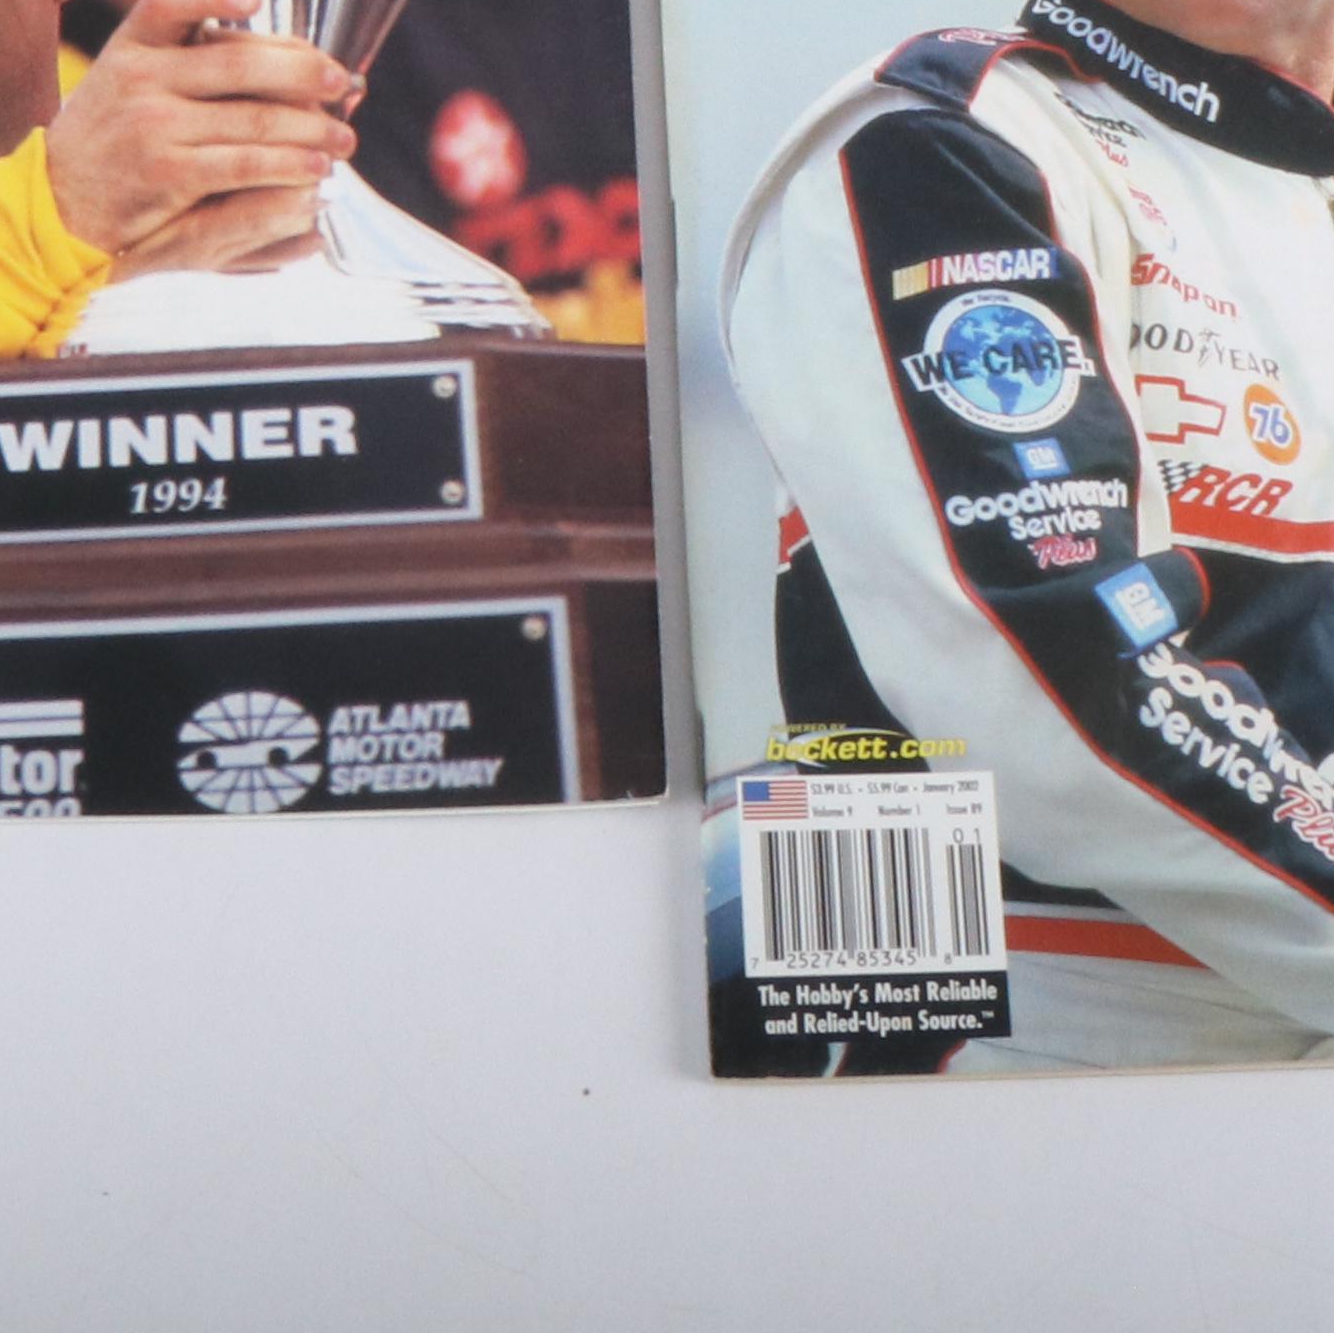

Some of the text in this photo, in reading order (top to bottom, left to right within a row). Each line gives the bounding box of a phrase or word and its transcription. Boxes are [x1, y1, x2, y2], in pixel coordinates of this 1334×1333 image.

[942, 248, 1050, 285] NASCAR
[914, 350, 973, 384] WE
[1252, 405, 1291, 445] 76
[129, 477, 228, 514] 1994
[1178, 464, 1293, 516] RCR
[1009, 507, 1101, 540] Service
[1028, 534, 1096, 570] Plus
[328, 700, 470, 734] ATLANTA
[328, 732, 445, 764] MOTOR
[767, 734, 965, 761] beckett.com
[1140, 687, 1273, 803] Service
[329, 757, 503, 795] SPEEDWAY
[923, 782, 955, 794] January
[812, 807, 843, 818] Volume
[878, 805, 912, 816] Number
[947, 804, 967, 815] Issue
[750, 950, 952, 969] 7 25274 85345 8
[757, 978, 997, 1010] The Hobby's Most Reliable
[765, 1013, 797, 1035] and
[804, 1011, 912, 1038] Relied-Upon
